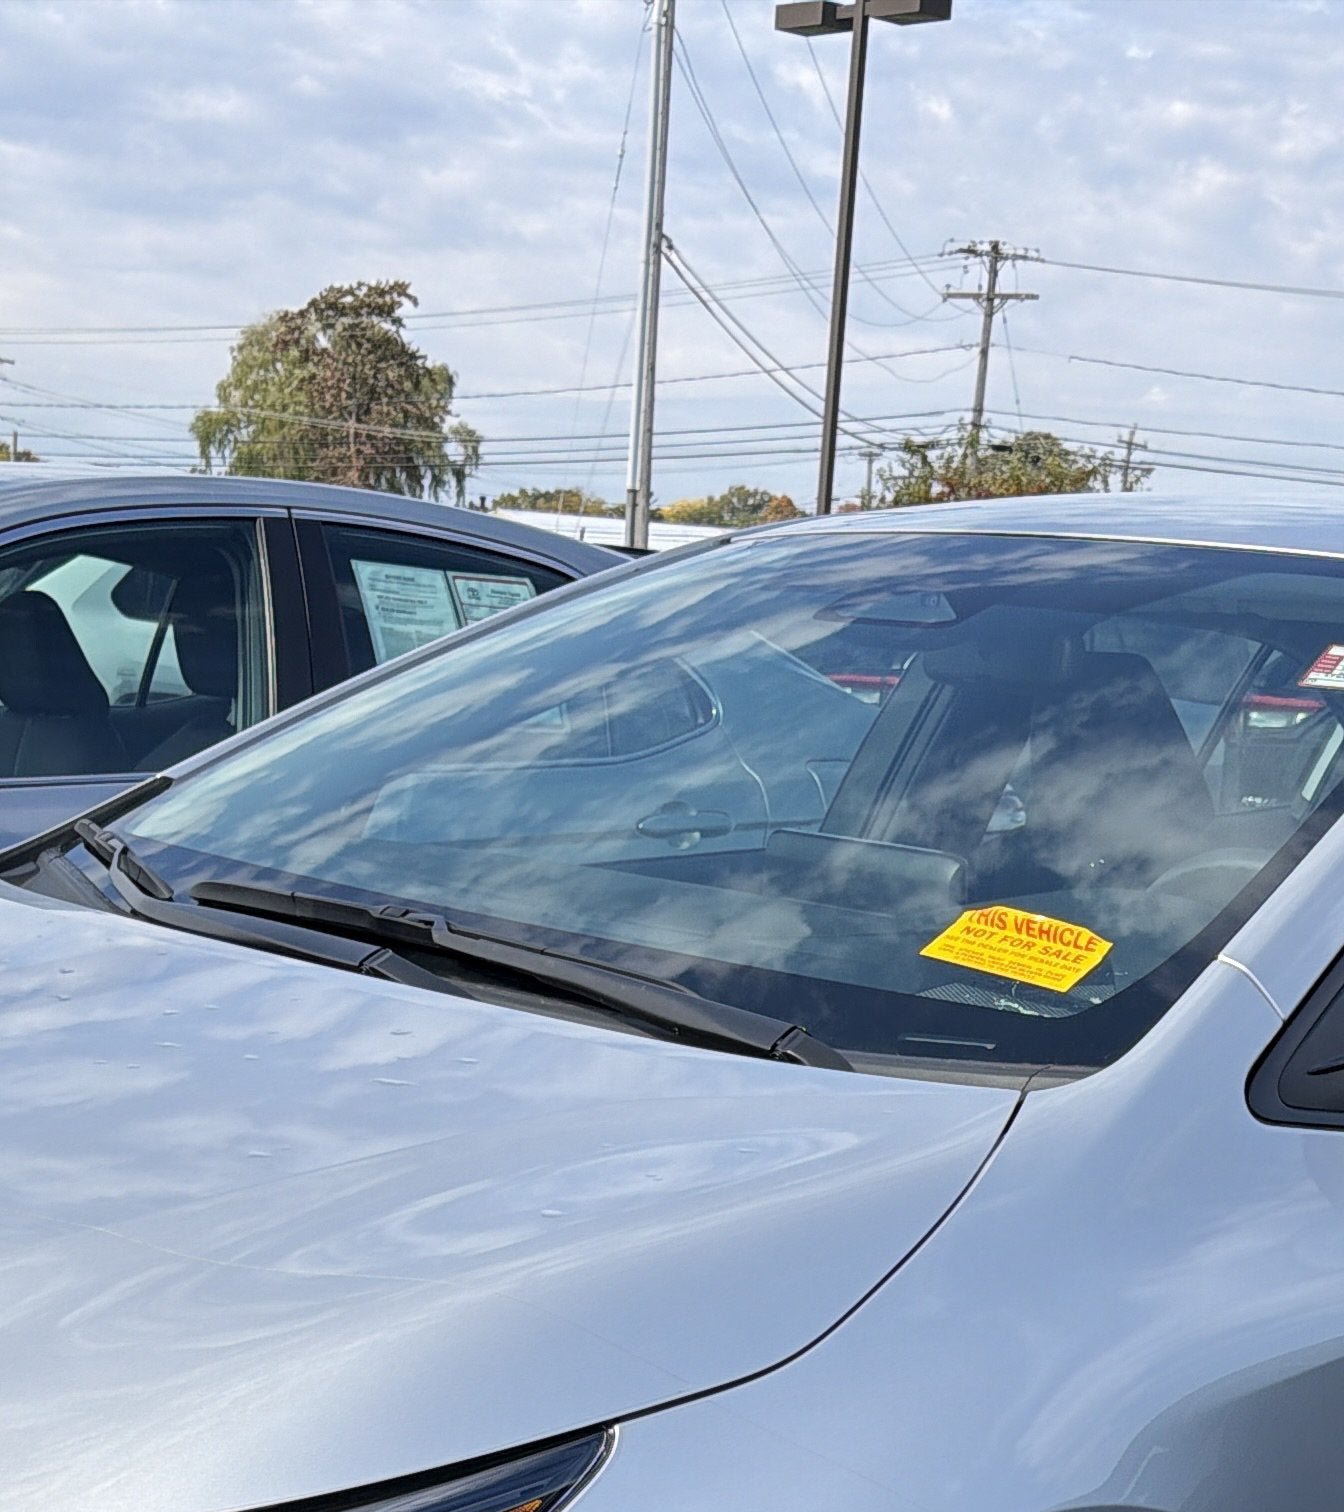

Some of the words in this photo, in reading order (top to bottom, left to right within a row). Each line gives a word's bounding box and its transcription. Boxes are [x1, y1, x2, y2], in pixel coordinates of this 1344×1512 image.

[960, 926, 998, 940] NOT
[998, 935, 1037, 951] FOR
[1038, 946, 1088, 965] SALE
[1014, 915, 1103, 953] VEHICLE
